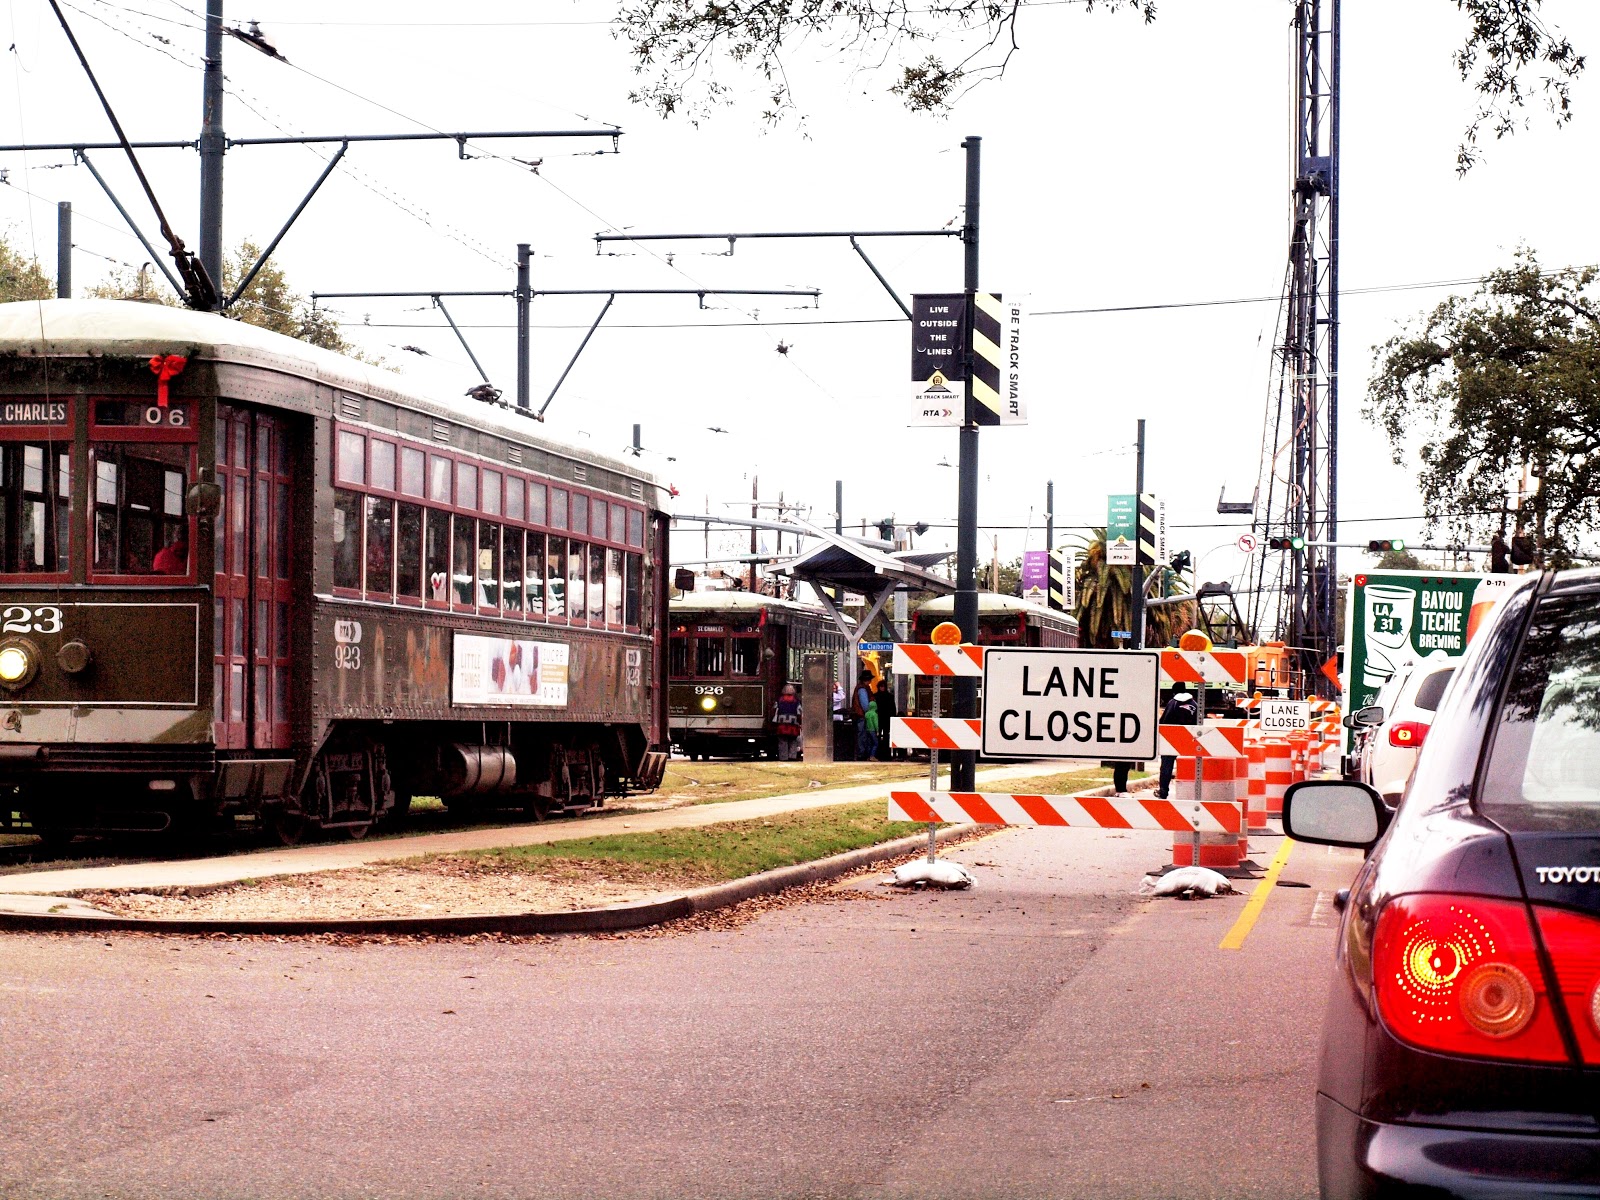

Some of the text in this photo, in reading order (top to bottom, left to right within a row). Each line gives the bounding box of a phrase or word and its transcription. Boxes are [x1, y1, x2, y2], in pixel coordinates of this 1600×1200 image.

[1009, 308, 1020, 416] BE TRACK SMART
[5, 403, 65, 421] CHARLES
[1421, 590, 1463, 609] BAYOU
[1375, 604, 1389, 617] LA
[0, 606, 64, 634] 23
[703, 625, 724, 633] CHARLES
[1380, 618, 1394, 631] 31
[1420, 611, 1462, 632] TECHE
[867, 643, 893, 651] Claiborne
[1419, 633, 1461, 649] BREWING
[335, 645, 361, 670] 923
[694, 686, 724, 695] 926
[1022, 665, 1119, 698] LANE
[1271, 705, 1299, 716] LANE
[999, 709, 1141, 743] CLOSED
[1264, 717, 1306, 728] CLOSED
[1535, 866, 1600, 884] TOYOT
